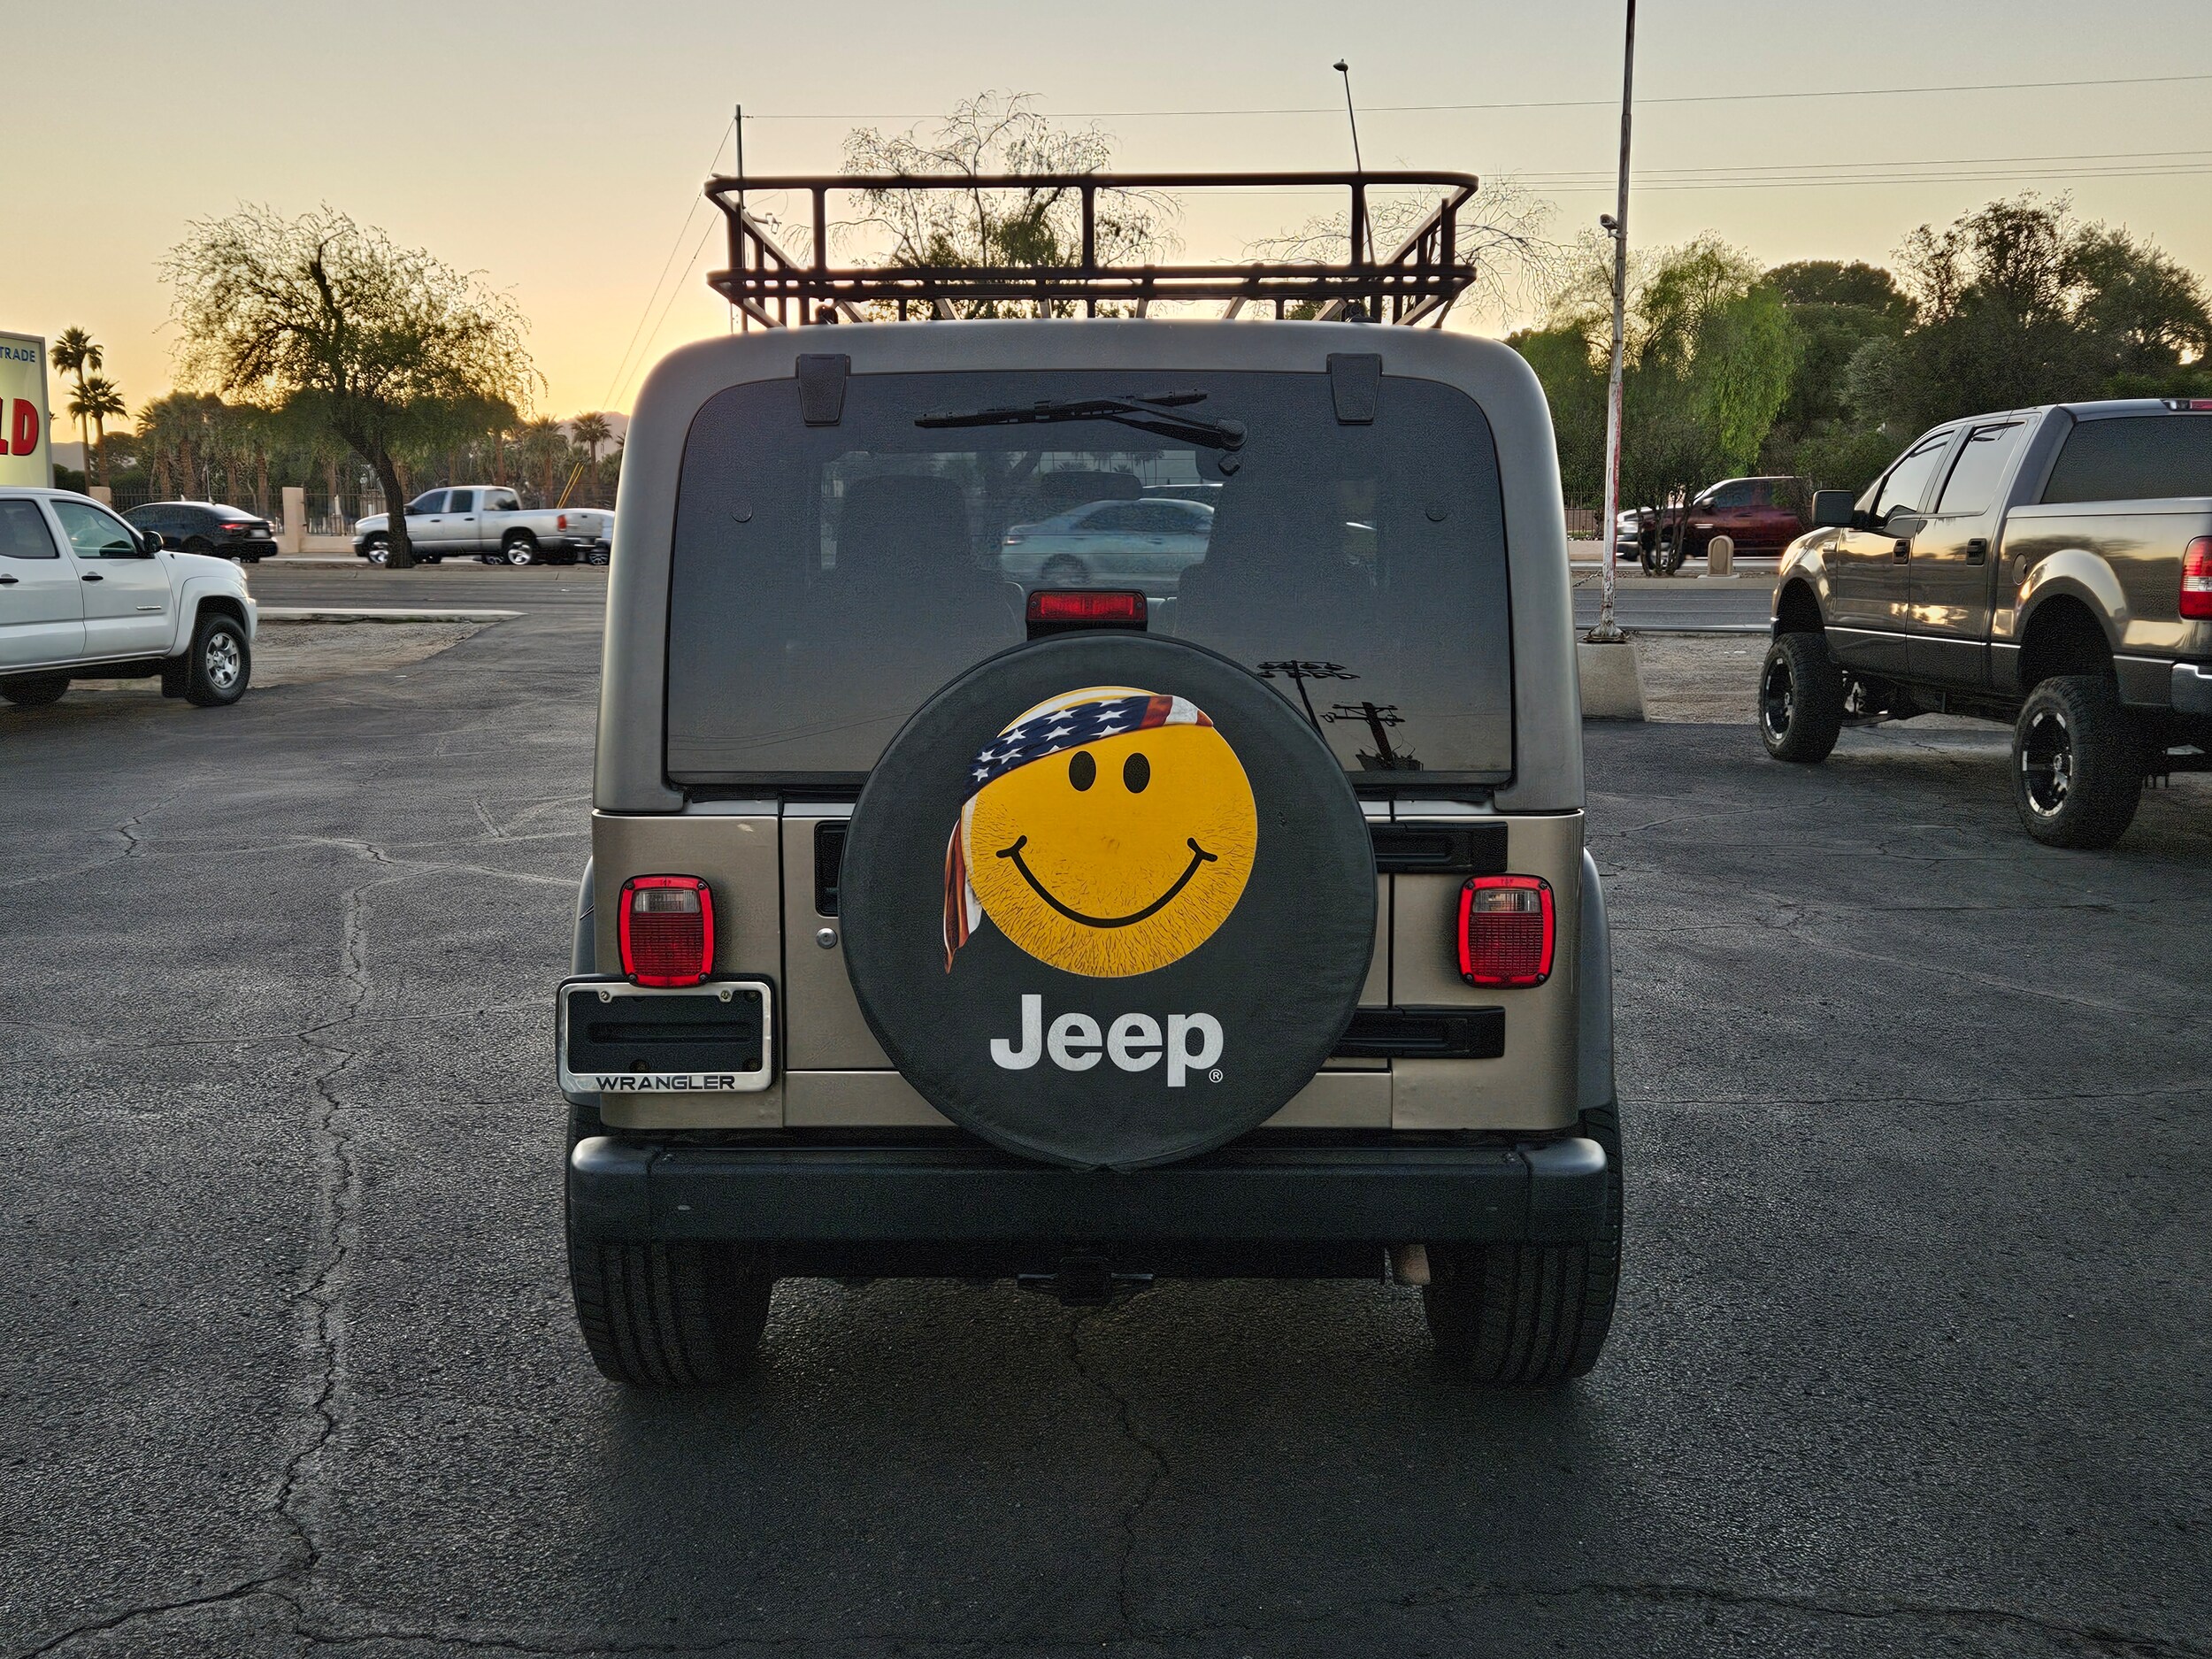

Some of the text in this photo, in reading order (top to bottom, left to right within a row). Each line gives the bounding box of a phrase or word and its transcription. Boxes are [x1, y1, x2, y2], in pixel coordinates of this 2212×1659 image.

[0, 346, 35, 363] TRADE
[990, 994, 1224, 1087] Jeep
[595, 1075, 735, 1090] WRANGLER
